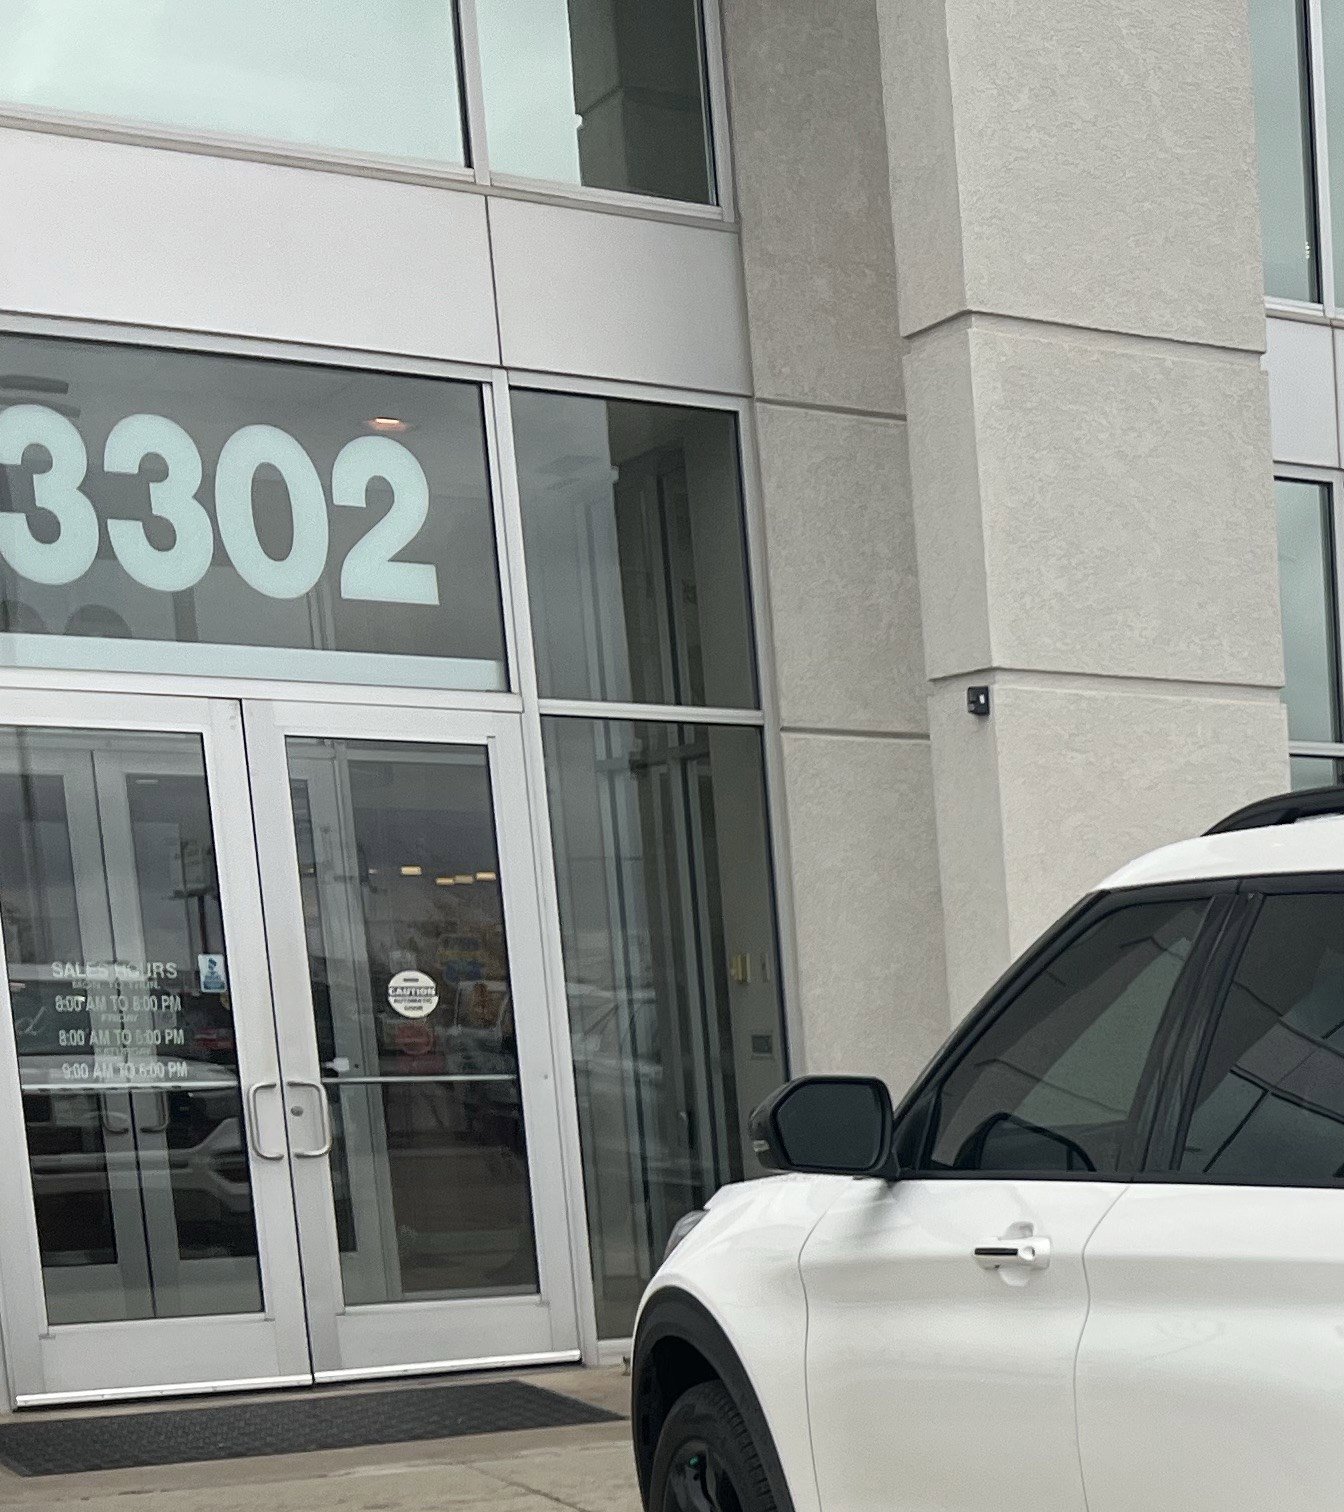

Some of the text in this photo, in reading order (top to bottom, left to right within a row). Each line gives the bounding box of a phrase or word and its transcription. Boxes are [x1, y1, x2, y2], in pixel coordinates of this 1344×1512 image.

[0, 404, 439, 606] 3302
[51, 962, 178, 979] SALES HOURS
[389, 986, 436, 997] CAUTION
[55, 995, 82, 1012] 8:00
[86, 995, 106, 1012] AM
[109, 995, 129, 1012] TO
[161, 995, 182, 1012] PM
[59, 1029, 85, 1046] 8:00
[89, 1029, 110, 1046] AM
[113, 1029, 132, 1046] TO
[165, 1029, 185, 1046] PM
[62, 1061, 188, 1080] 9:00 AM TO 6:00 PM
